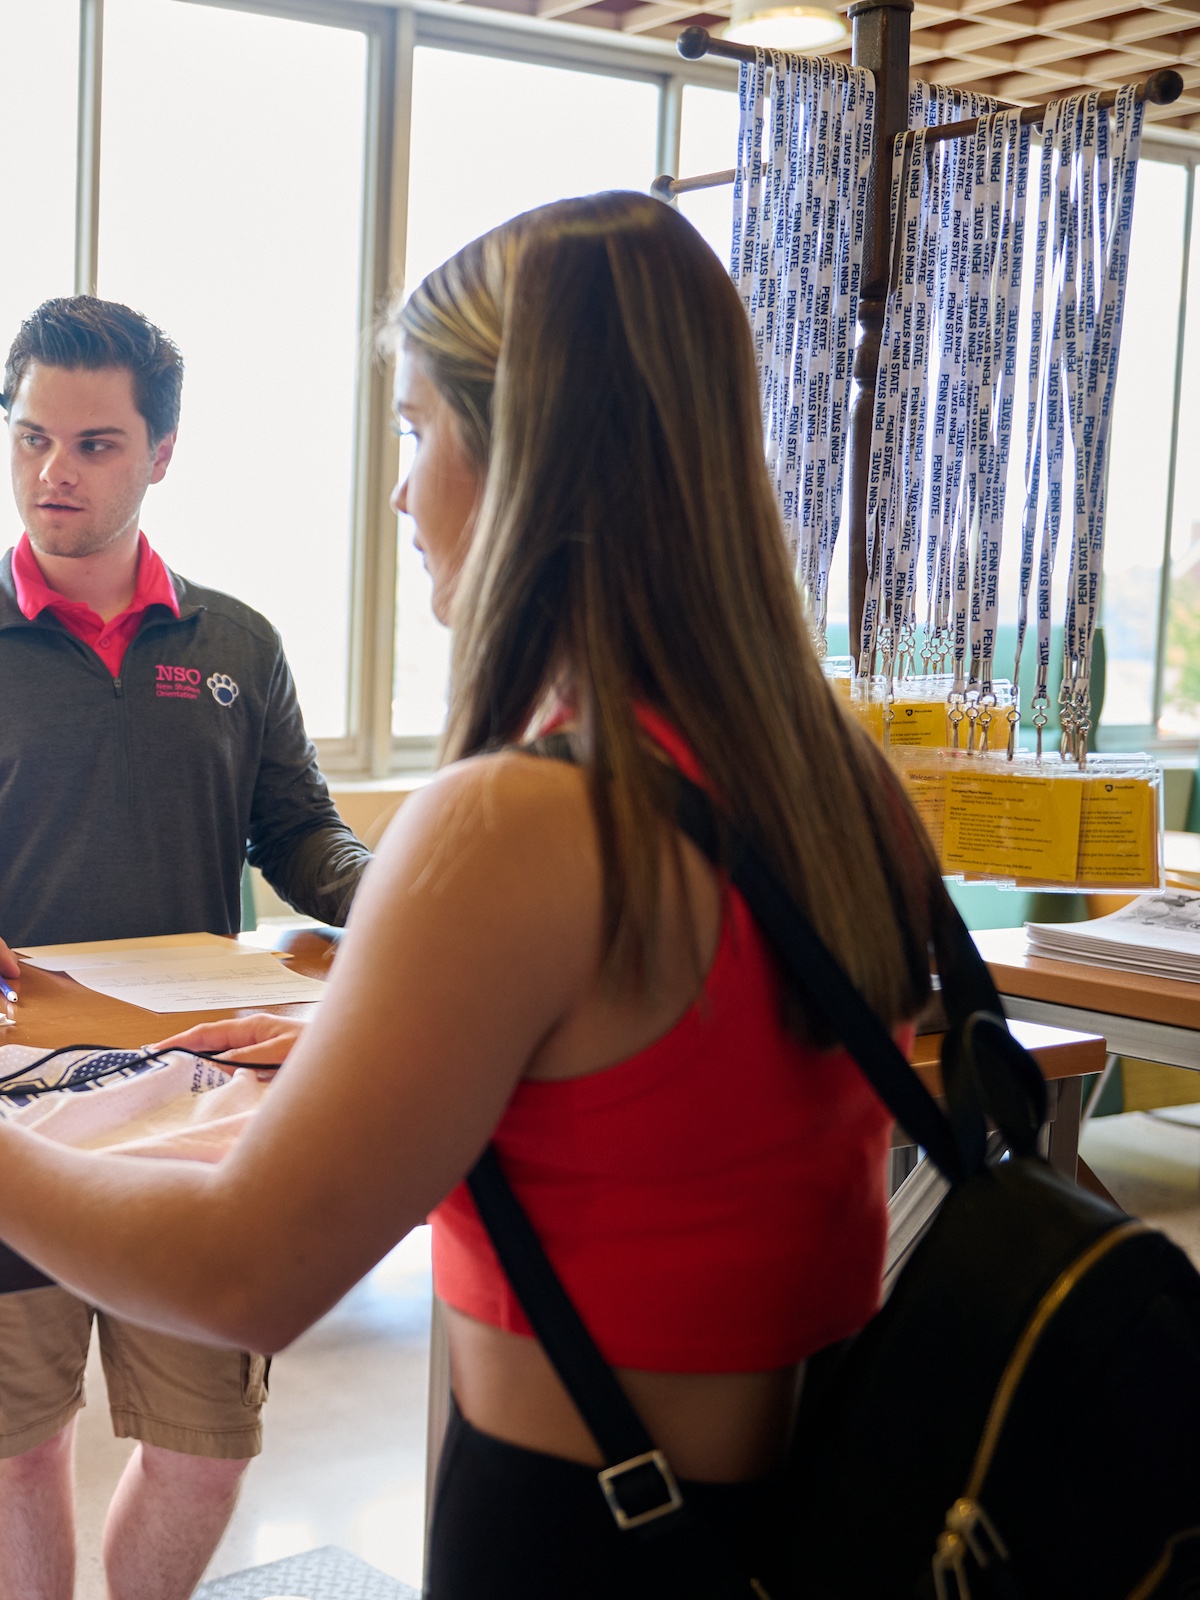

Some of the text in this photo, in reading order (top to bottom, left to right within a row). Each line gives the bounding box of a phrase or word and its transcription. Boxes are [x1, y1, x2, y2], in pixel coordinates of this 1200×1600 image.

[774, 81, 784, 152] PENN STATE.
[815, 110, 829, 180] PENN STATE.
[862, 91, 874, 159] PENN STATE.
[991, 112, 1004, 182] PENN STATE.
[1009, 120, 1017, 150] PENN
[1084, 116, 1094, 147] PENN
[1116, 97, 1126, 138] STATE.
[1130, 102, 1142, 142] STATE.
[751, 118, 763, 188] PENN STATE.
[842, 129, 852, 198] PENN STATE.
[910, 130, 923, 199] PENN STATE.
[976, 115, 988, 185] PENN STATE.
[1017, 126, 1030, 198] PENN STATE.
[1041, 129, 1053, 202] PENN STATE.
[1125, 161, 1135, 194] PENN
[773, 169, 781, 199] PENN
[812, 197, 821, 227] PENN
[854, 177, 866, 246] PENN STATE.
[964, 173, 972, 201] PENN
[732, 217, 741, 254] STATE.
[742, 207, 757, 277] PENN STATE.
[790, 202, 801, 272] PENN STATE.
[802, 234, 811, 263] PENN
[824, 199, 836, 269] PENN STATE.
[905, 216, 917, 285] PENN STATE.
[950, 211, 962, 276] PENN STATE.
[972, 203, 984, 274] PENN STATE.
[991, 201, 1000, 238] STATE.
[1011, 216, 1024, 287] PENN STATE.
[758, 239, 769, 308] PENN STATE.
[840, 266, 849, 295] PENN
[850, 263, 860, 293] PENN
[926, 231, 937, 297] PENN STATE.
[959, 255, 967, 283] PENN
[1035, 221, 1047, 293] PENN STATE.
[785, 290, 796, 358] PENN STATE.
[820, 286, 830, 315] PENN
[944, 292, 956, 357] PENN STATE.
[968, 292, 979, 362] PENN STATE.
[979, 298, 988, 328] PENN
[835, 313, 846, 380] PENN STATE.
[902, 302, 912, 370] PENN STATE.
[913, 302, 926, 370] PENN STATE.
[1005, 305, 1018, 376] PENN STATE.
[1029, 312, 1041, 384] PENN STATE.
[1066, 300, 1076, 372] PENN STATE.
[1100, 300, 1115, 374] PENN STATE.
[794, 353, 802, 389] STATE.
[876, 363, 888, 430] PENN STATE.
[890, 362, 900, 398] STATE.
[982, 357, 991, 386] PENN
[1049, 358, 1059, 430] PENN STATE.
[1087, 359, 1099, 397] STATE.
[807, 375, 817, 443] PENN STATE.
[831, 397, 842, 464] PENN STATE.
[936, 374, 949, 438] PENN STATE.
[949, 381, 959, 445] PENN STATE.
[978, 403, 989, 473] PENN STATE.
[1000, 394, 1012, 464] PENN STATE.
[786, 406, 799, 473] PENN STATE.
[871, 448, 882, 484] STATE.
[883, 415, 894, 481] PENN STATE.
[956, 423, 965, 458] STATE.
[803, 460, 814, 527] PENN STATE.
[817, 459, 825, 488] PENN
[931, 485, 941, 519] STATE.
[1051, 482, 1060, 512] PENN
[1076, 483, 1085, 514] PENN
[1024, 527, 1034, 564] STATE.
[1092, 516, 1103, 554] STATE.
[896, 572, 906, 601] PENN
[985, 542, 998, 611] PENN STATE.
[1040, 548, 1049, 619] PENN STATE.
[1078, 533, 1088, 605] PENN STATE.
[956, 608, 966, 644] STATE.
[983, 629, 993, 658] PENN
[155, 664, 201, 685] NSO
[156, 690, 197, 699] Orientation
